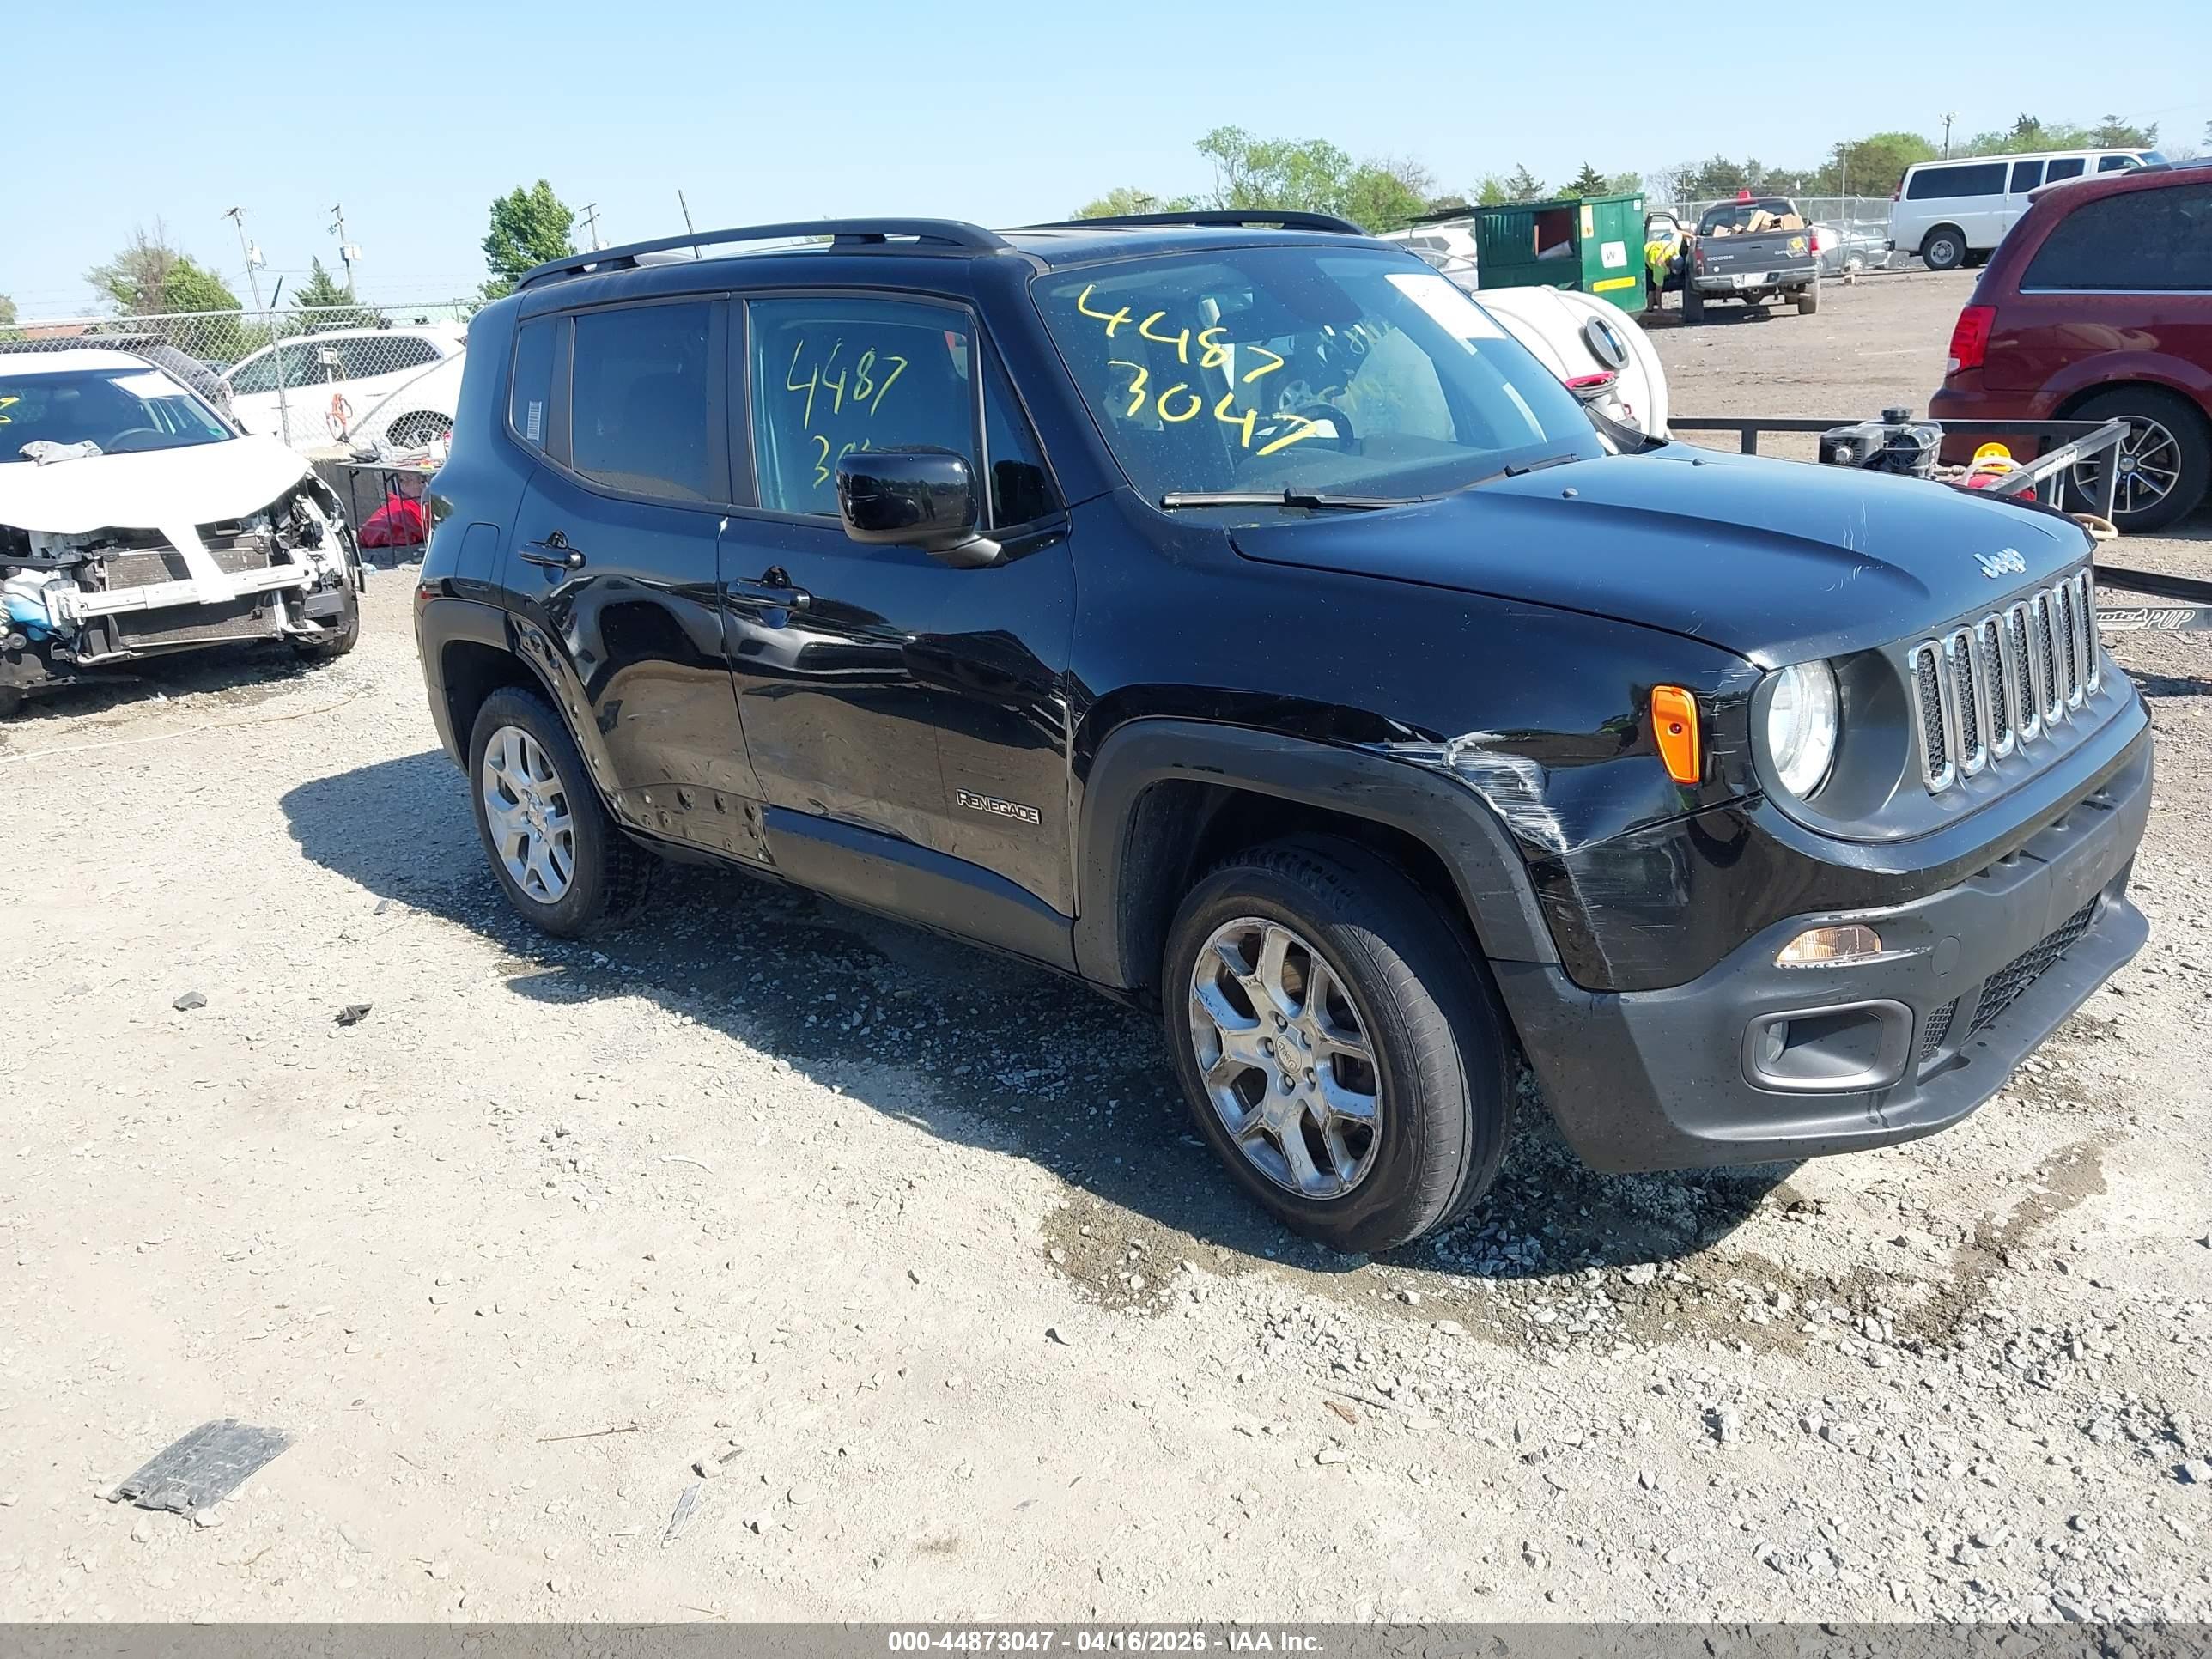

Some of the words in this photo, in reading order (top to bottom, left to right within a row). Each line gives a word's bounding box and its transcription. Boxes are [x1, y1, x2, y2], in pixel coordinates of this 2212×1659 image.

[1077, 283, 1285, 383] 4487
[787, 338, 908, 430] 4487
[1107, 360, 1319, 455] 3047
[1973, 547, 2027, 579] Jeep
[955, 788, 1042, 825] RENEGADE
